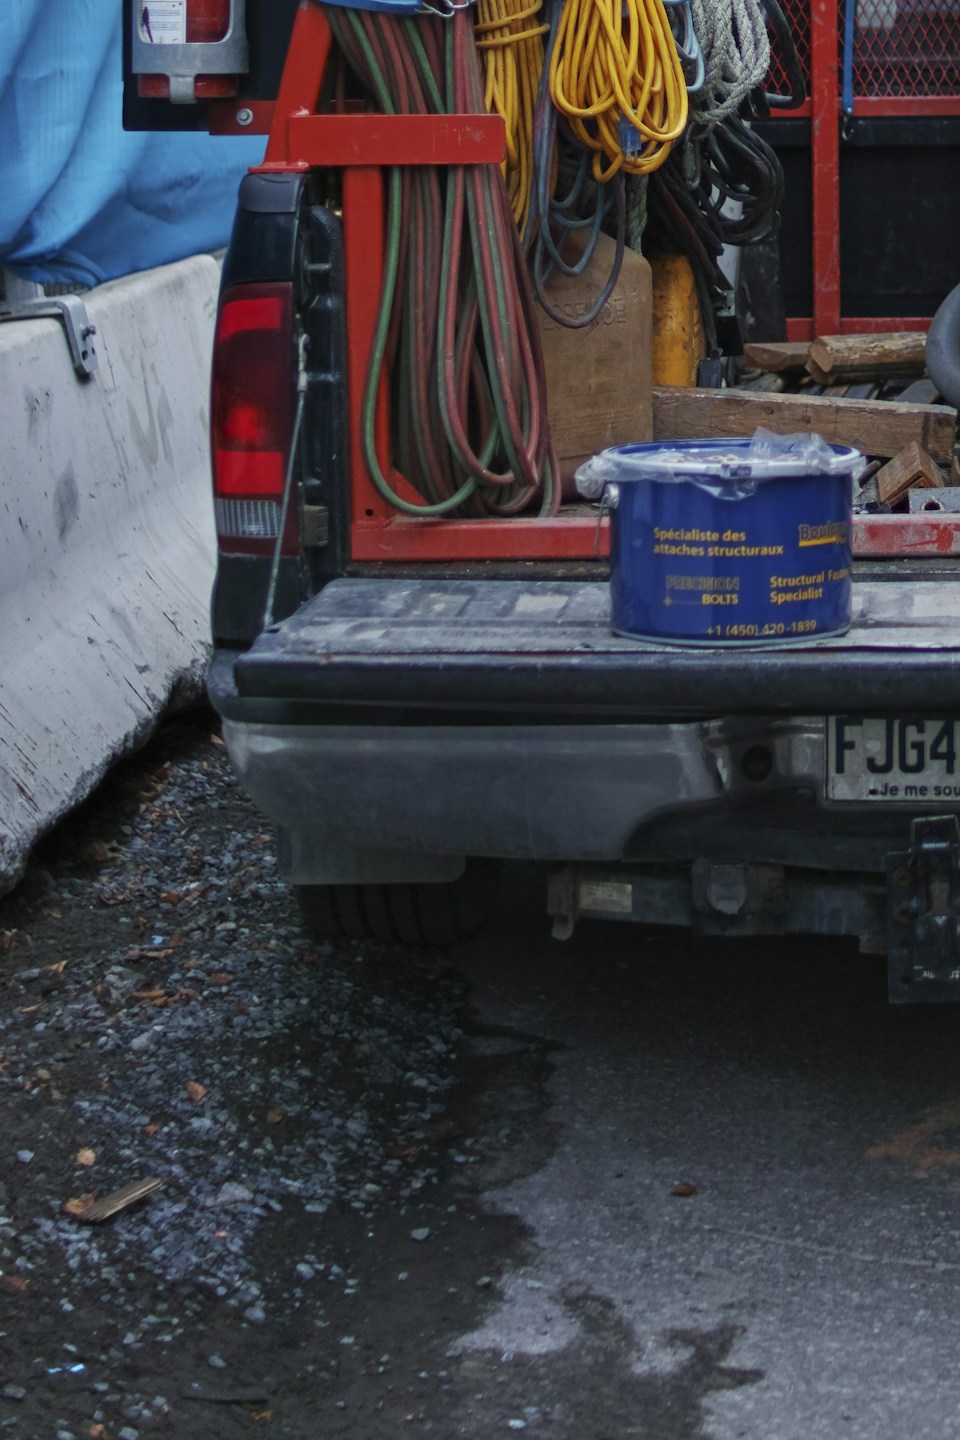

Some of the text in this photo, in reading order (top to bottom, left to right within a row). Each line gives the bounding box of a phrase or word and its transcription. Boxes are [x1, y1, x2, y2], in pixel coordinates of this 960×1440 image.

[653, 527, 746, 542] Spécialiste des
[798, 520, 847, 541] Boul
[653, 544, 783, 557] attaches structuraux
[666, 575, 740, 590] PRECISION
[770, 571, 825, 588] Structural
[702, 594, 739, 606] BOLTS
[770, 588, 823, 606] Specialist
[706, 626, 722, 637] +1
[726, 624, 759, 638] (450)
[880, 782, 899, 796] Je
[904, 784, 928, 796] me
